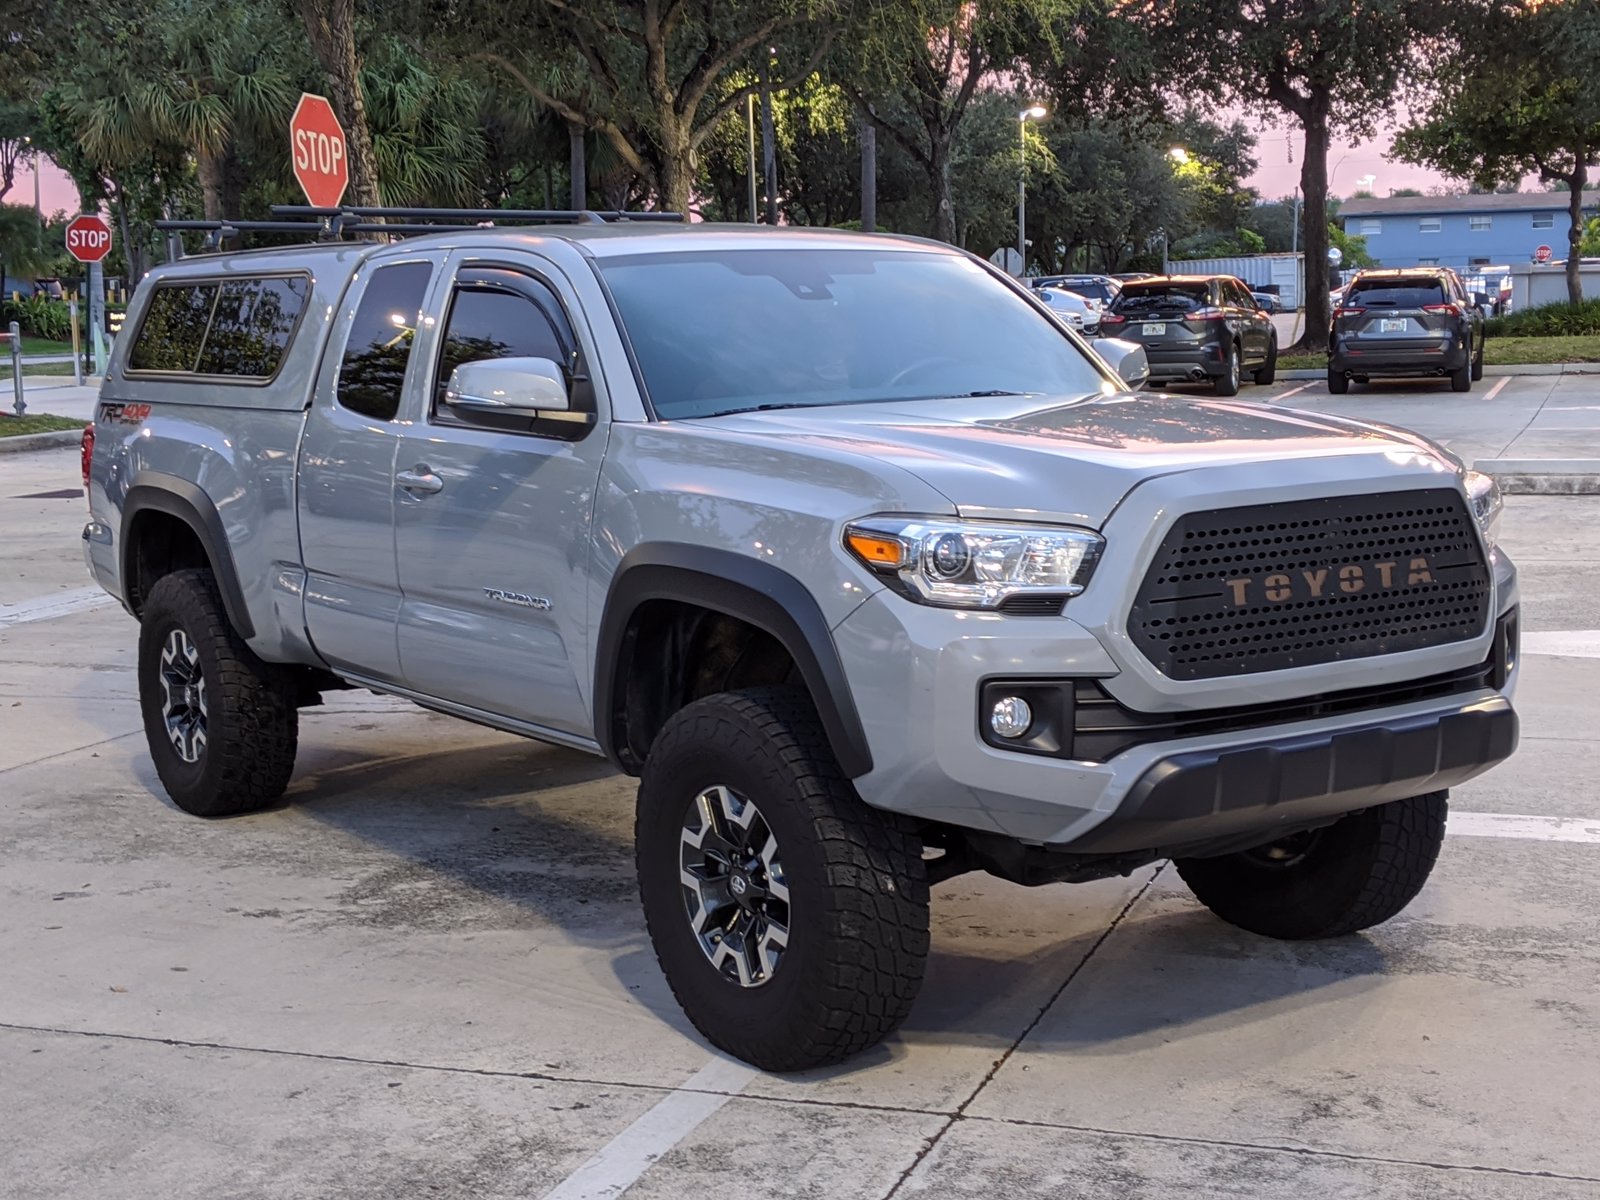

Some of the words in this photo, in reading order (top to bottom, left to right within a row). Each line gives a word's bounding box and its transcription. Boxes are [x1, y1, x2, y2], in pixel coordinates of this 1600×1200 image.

[296, 128, 343, 176] STOP
[69, 229, 109, 248] STOP
[1536, 249, 1552, 257] STOP
[99, 402, 126, 423] TRD
[1226, 557, 1433, 607] TOYOTA
